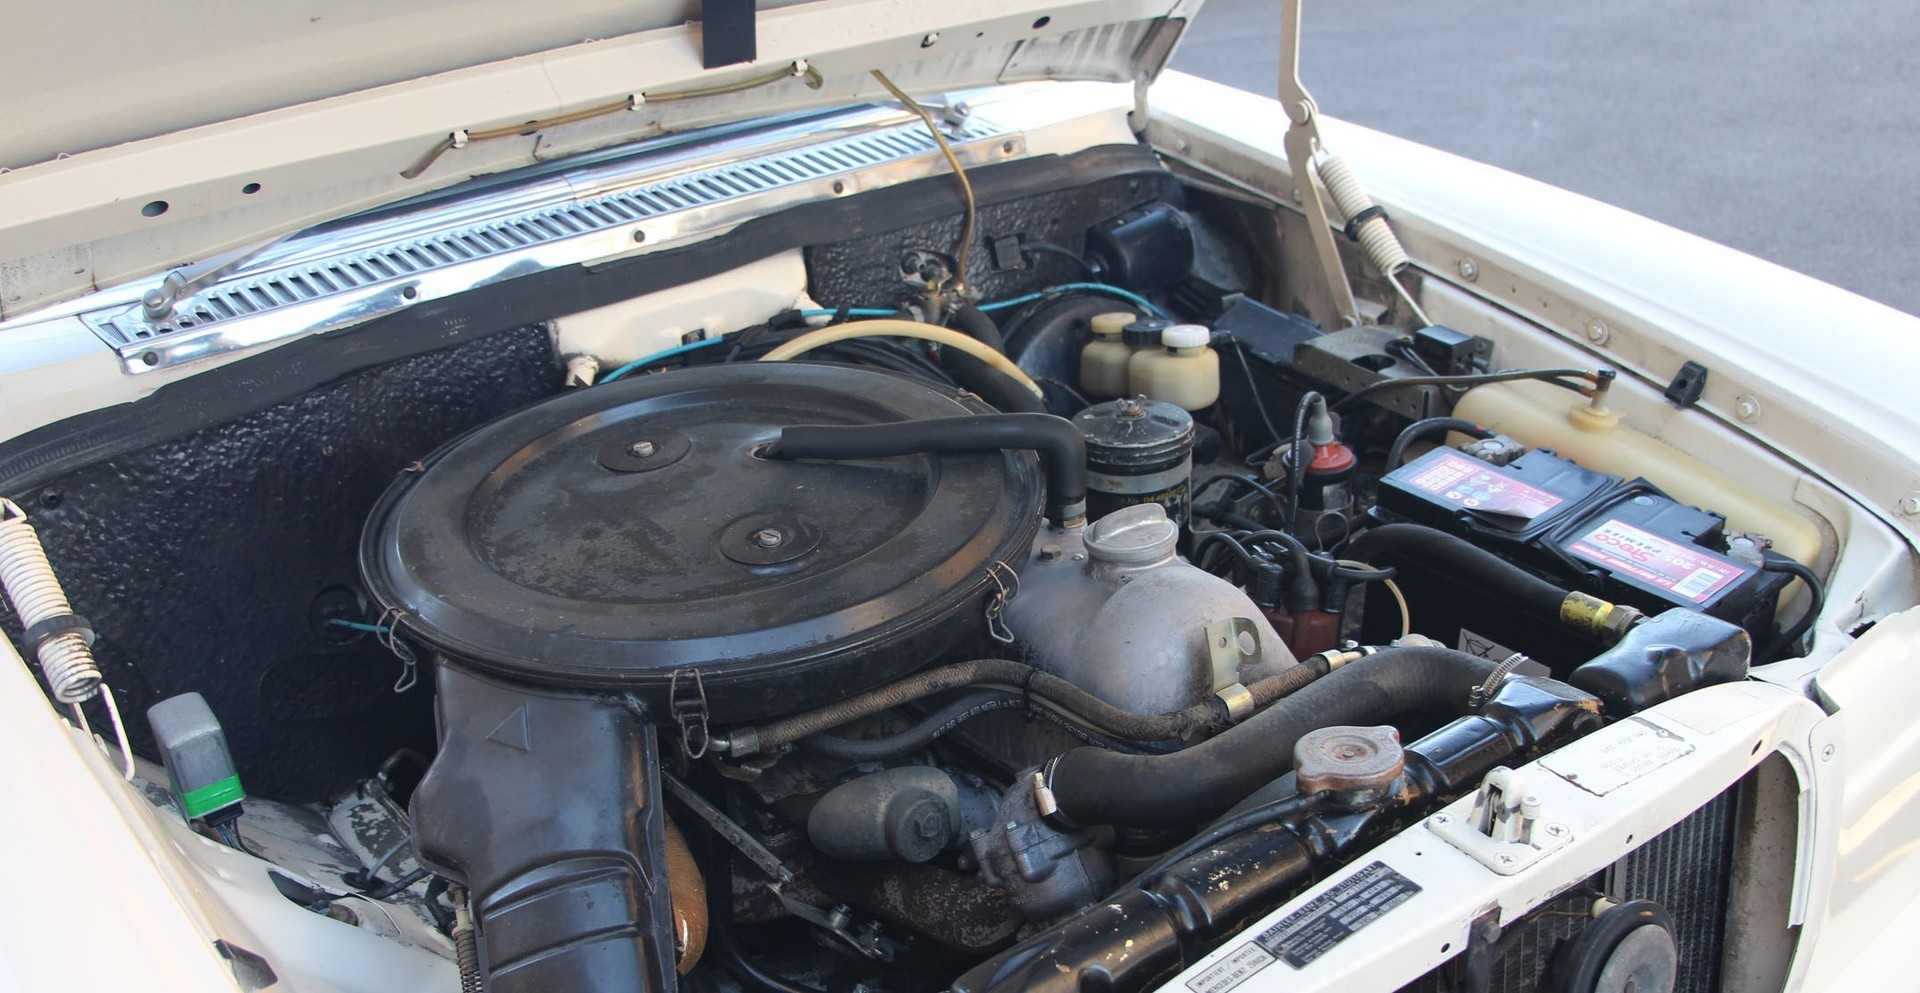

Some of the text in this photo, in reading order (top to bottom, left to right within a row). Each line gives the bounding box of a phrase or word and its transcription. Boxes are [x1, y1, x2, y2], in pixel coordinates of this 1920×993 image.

[1603, 529, 1662, 554] PREMIER
[1664, 554, 1696, 570] 205
[1262, 897, 1321, 938] DAIMLER-BENZ
[1336, 864, 1377, 890] STUTTGART
